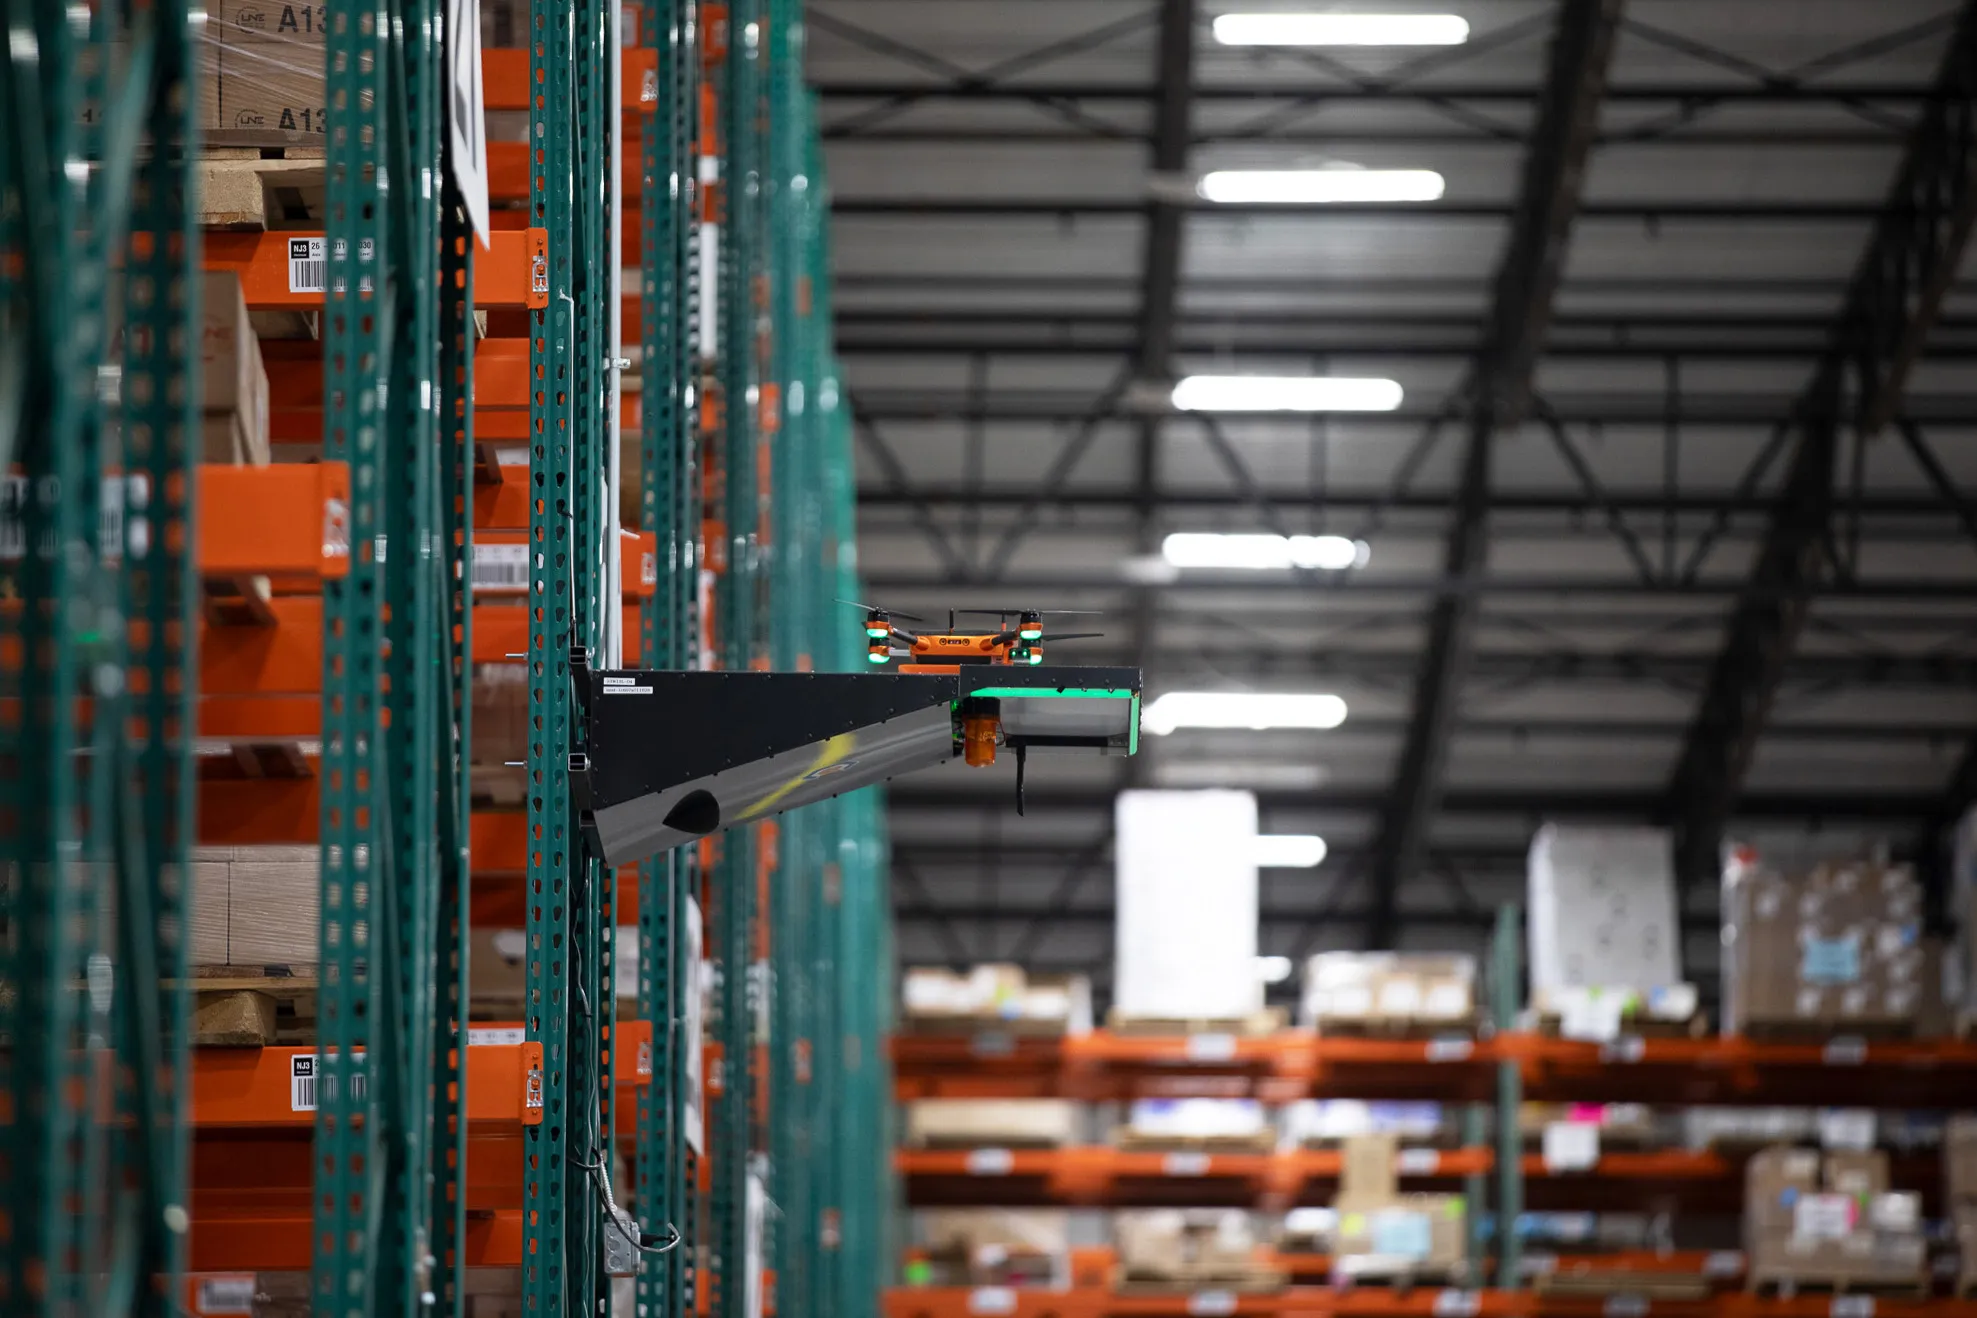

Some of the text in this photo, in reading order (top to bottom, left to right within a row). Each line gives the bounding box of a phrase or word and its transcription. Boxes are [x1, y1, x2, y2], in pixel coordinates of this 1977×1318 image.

[293, 244, 308, 253] NJ3
[311, 242, 320, 250] 26
[296, 1061, 310, 1070] NJ3
